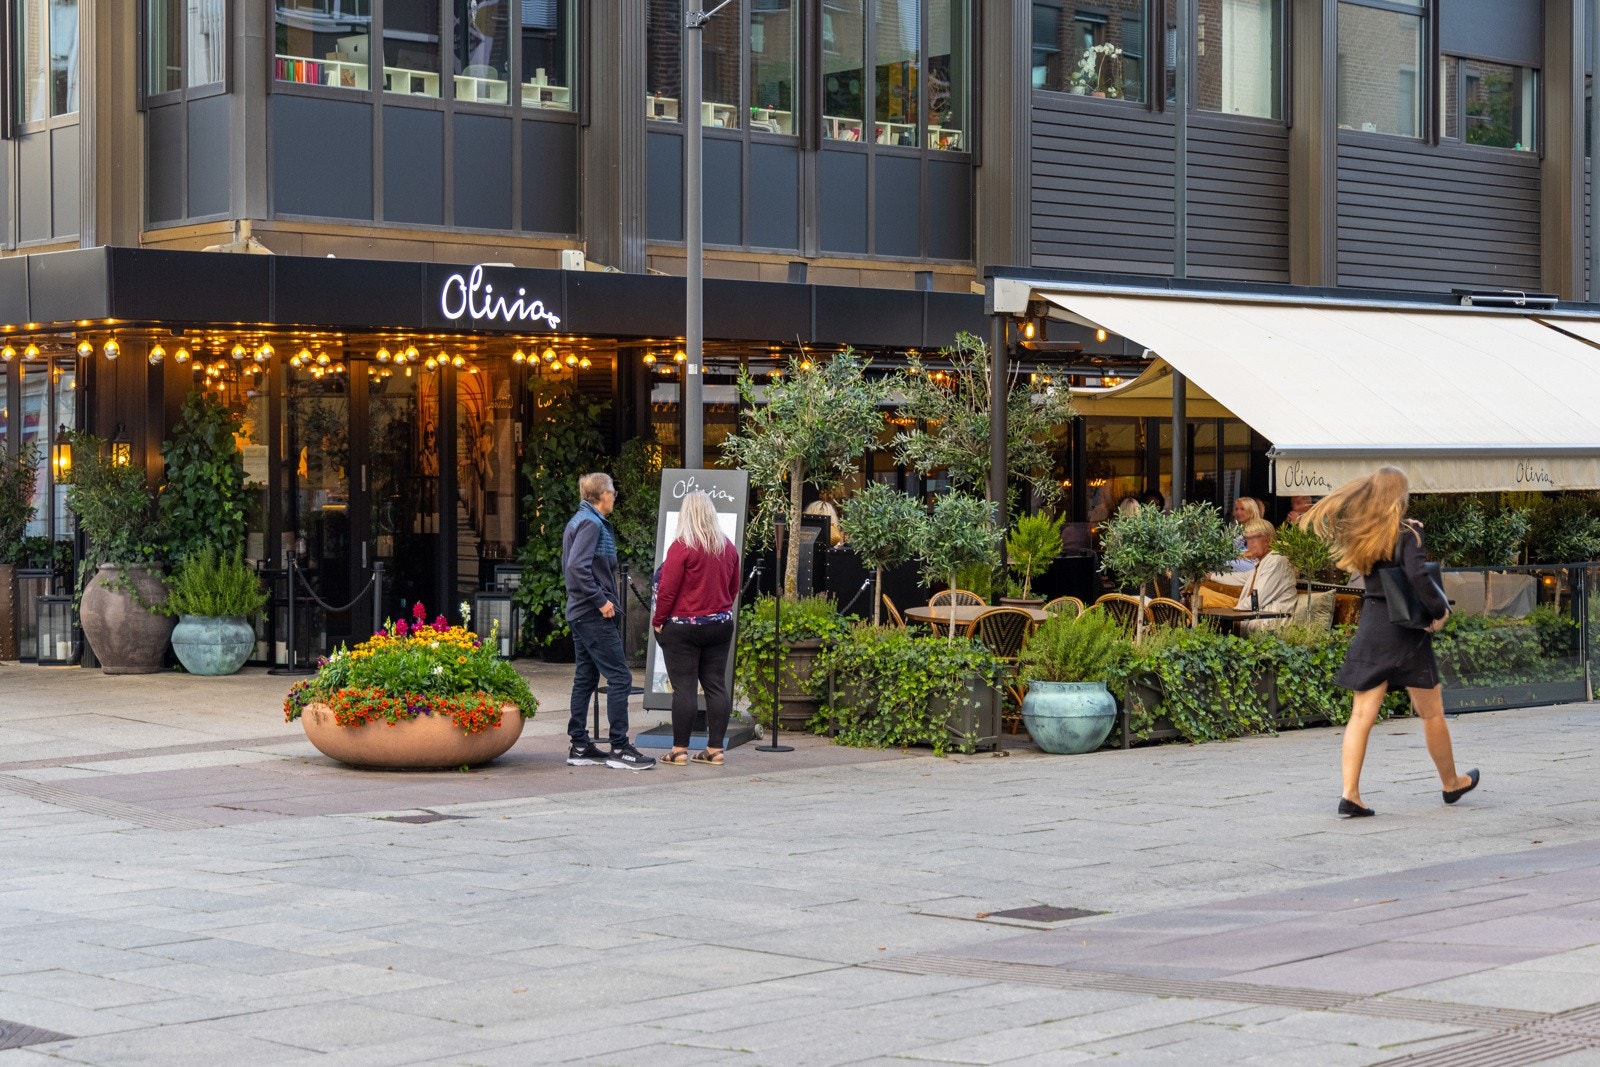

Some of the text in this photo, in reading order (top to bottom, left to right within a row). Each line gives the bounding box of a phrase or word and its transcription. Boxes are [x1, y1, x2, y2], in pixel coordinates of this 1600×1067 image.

[442, 264, 560, 329] Olivia
[1285, 460, 1332, 491] Olivia
[1516, 457, 1554, 487] Olivia
[672, 476, 735, 502] Olia
